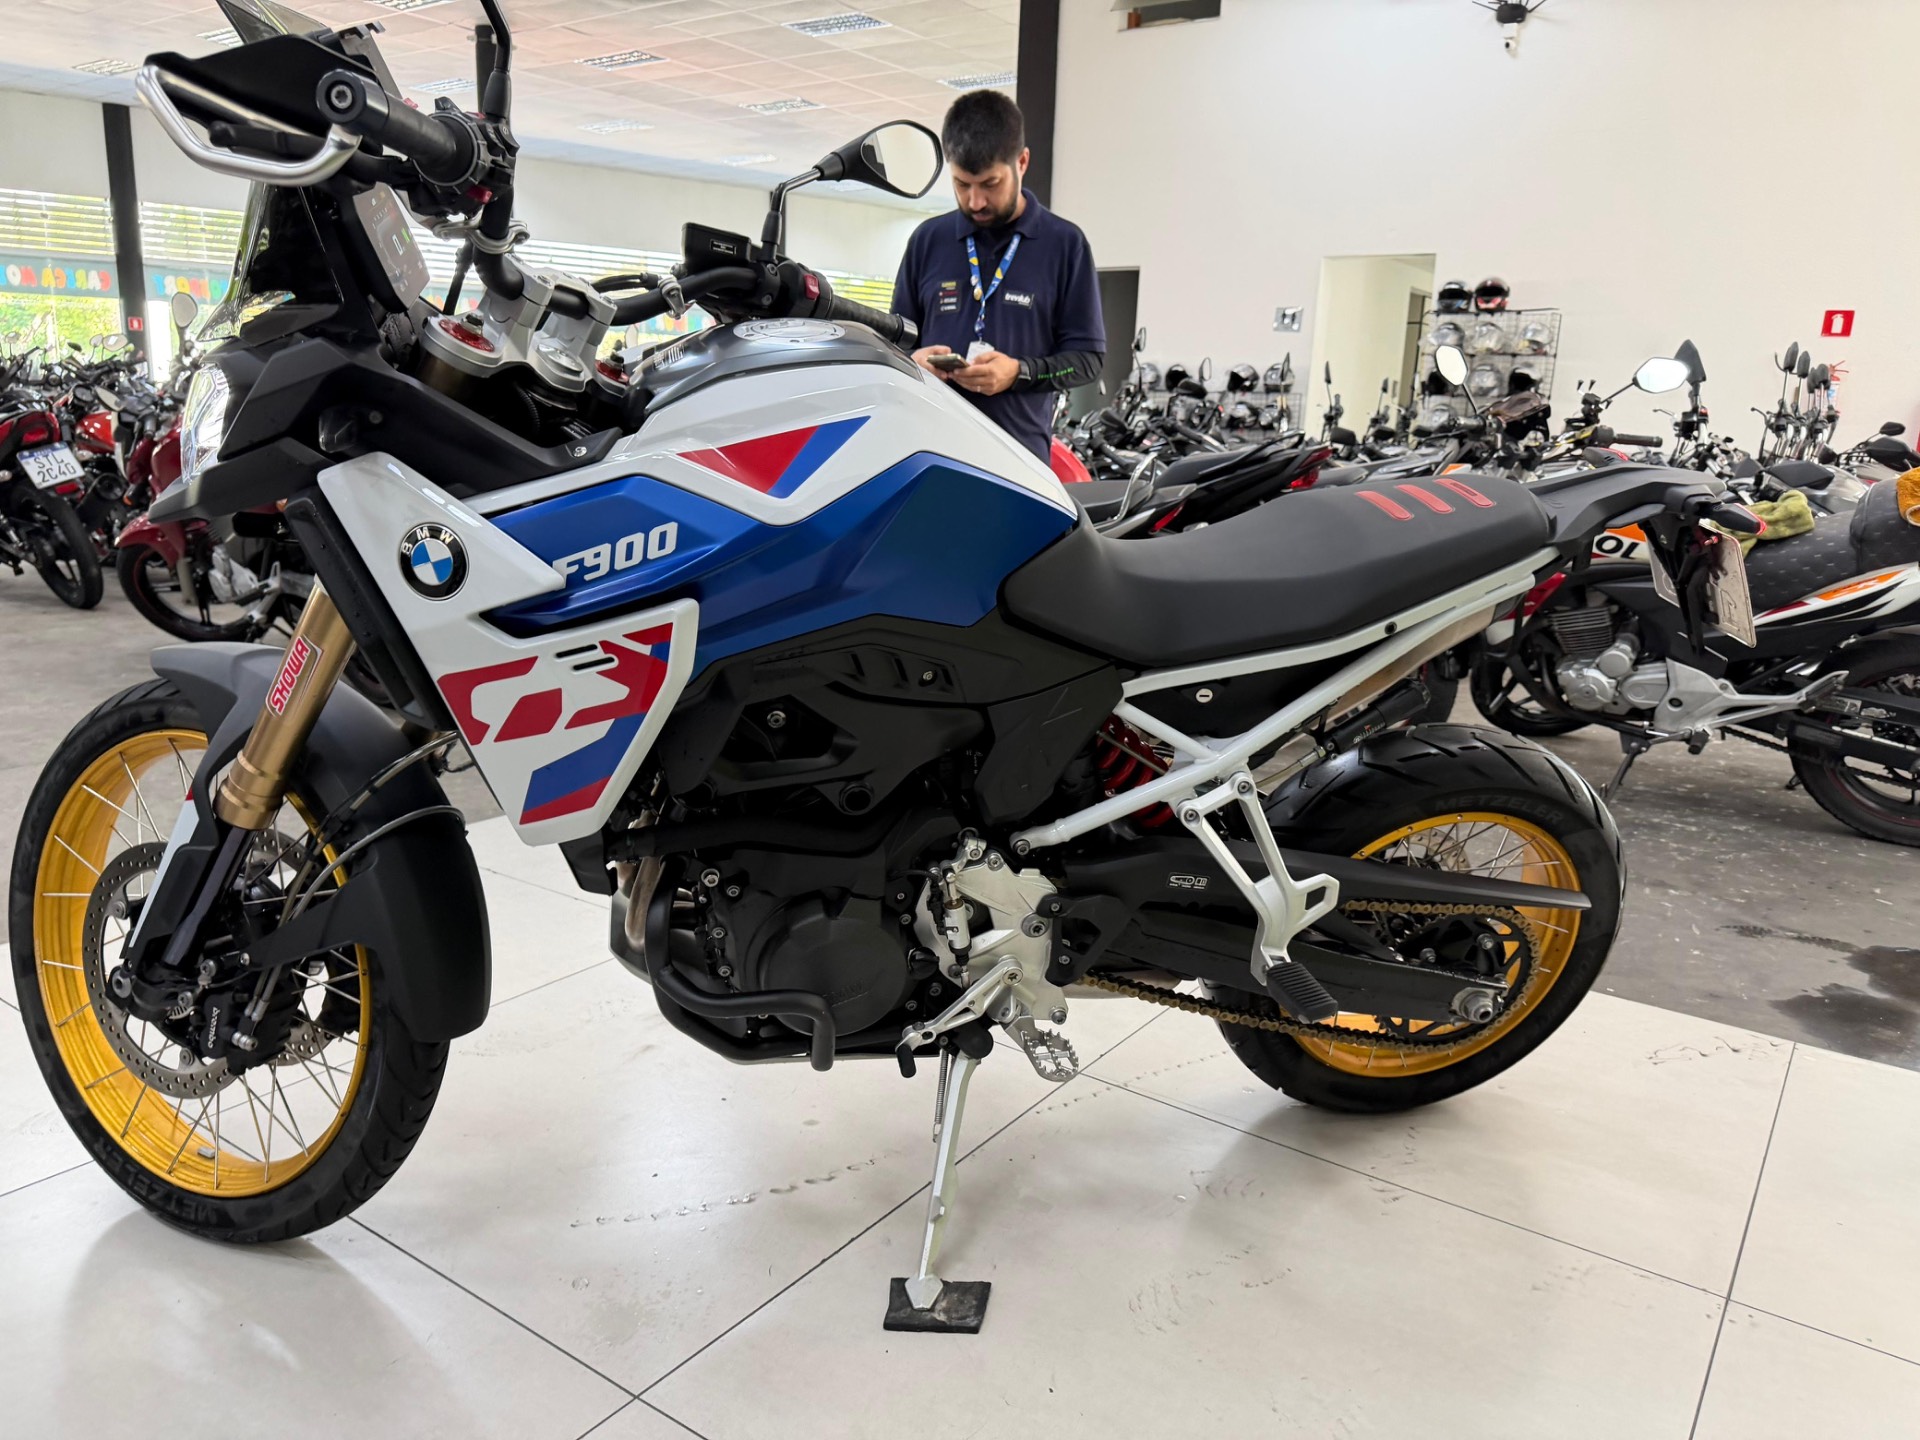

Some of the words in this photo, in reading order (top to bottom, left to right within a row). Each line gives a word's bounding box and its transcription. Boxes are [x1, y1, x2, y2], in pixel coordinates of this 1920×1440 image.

[34, 453, 64, 469] STL
[401, 526, 455, 557] BMW
[552, 521, 679, 588] F900
[270, 636, 311, 716] SHOWA
[1434, 794, 1565, 823] METZELER
[207, 1006, 221, 1049] brembo
